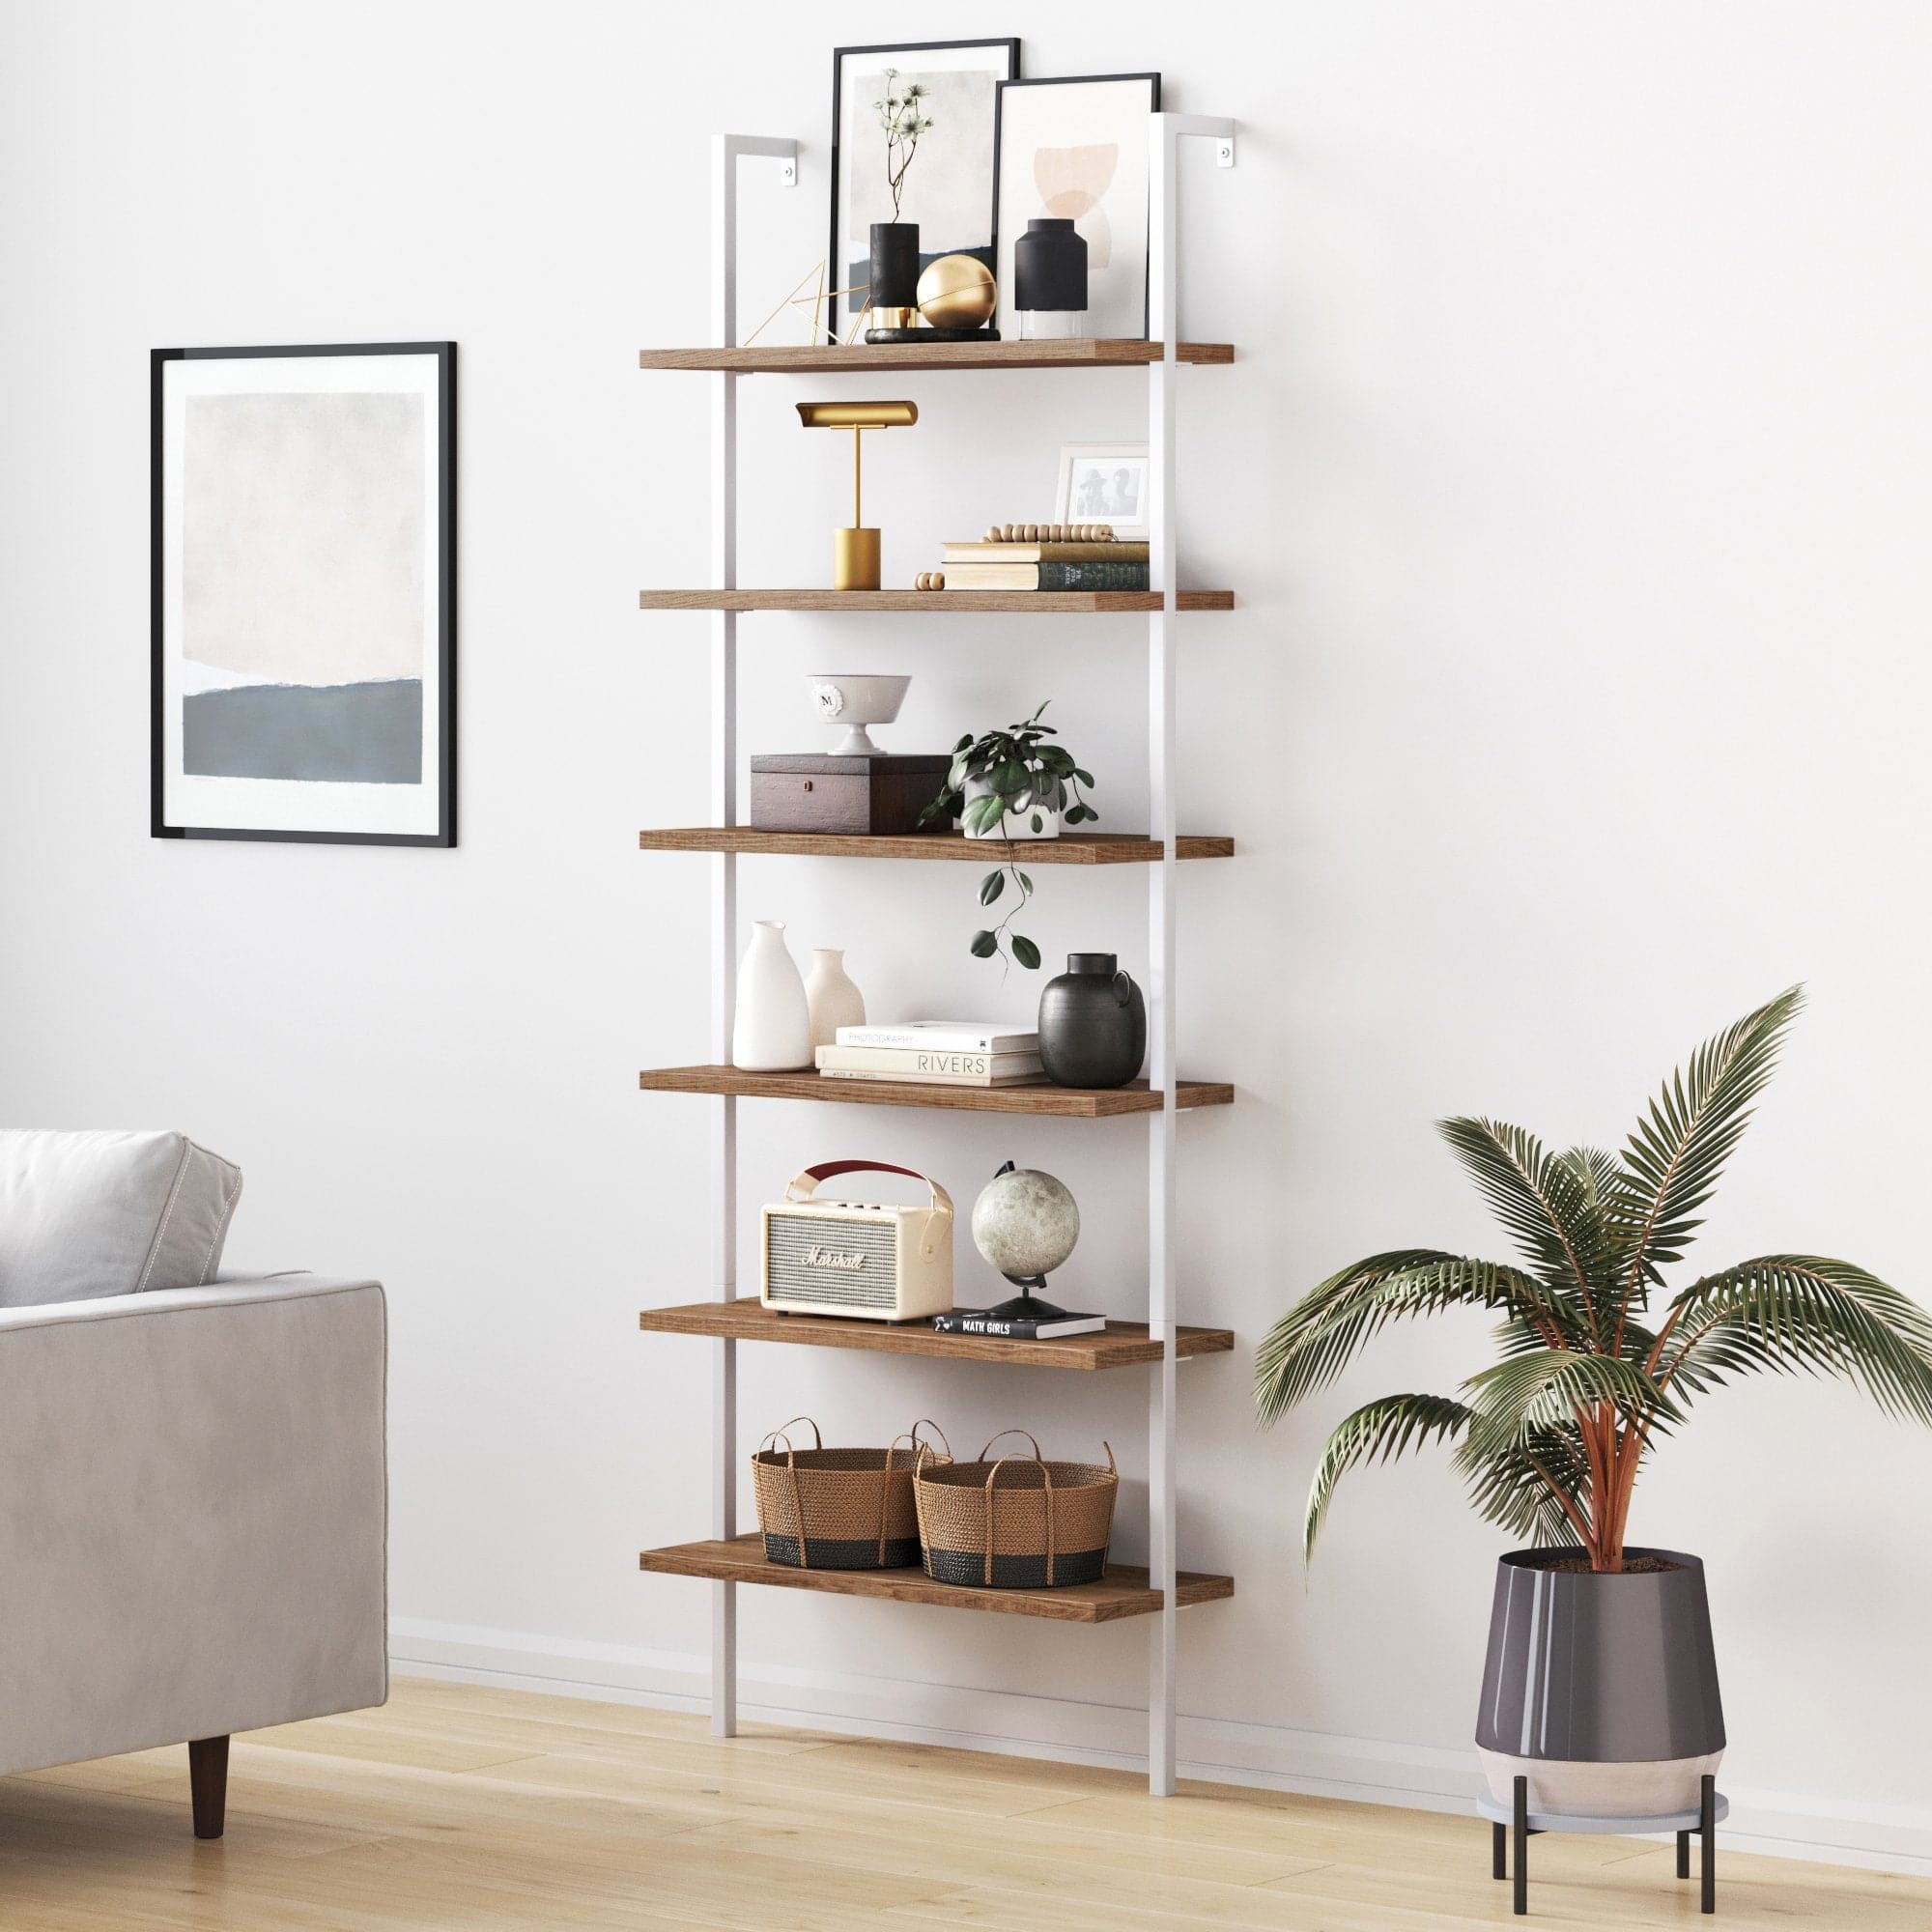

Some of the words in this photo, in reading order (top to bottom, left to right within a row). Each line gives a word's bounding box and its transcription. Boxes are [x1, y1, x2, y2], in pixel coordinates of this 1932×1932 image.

[821, 696, 833, 706] M
[849, 1033, 914, 1044] PHOTOGRAPHY
[918, 1055, 984, 1074] RIVERS
[802, 1245, 866, 1268] Marshall
[962, 1320, 985, 1332] MATH
[986, 1321, 1010, 1335] GIRLS
